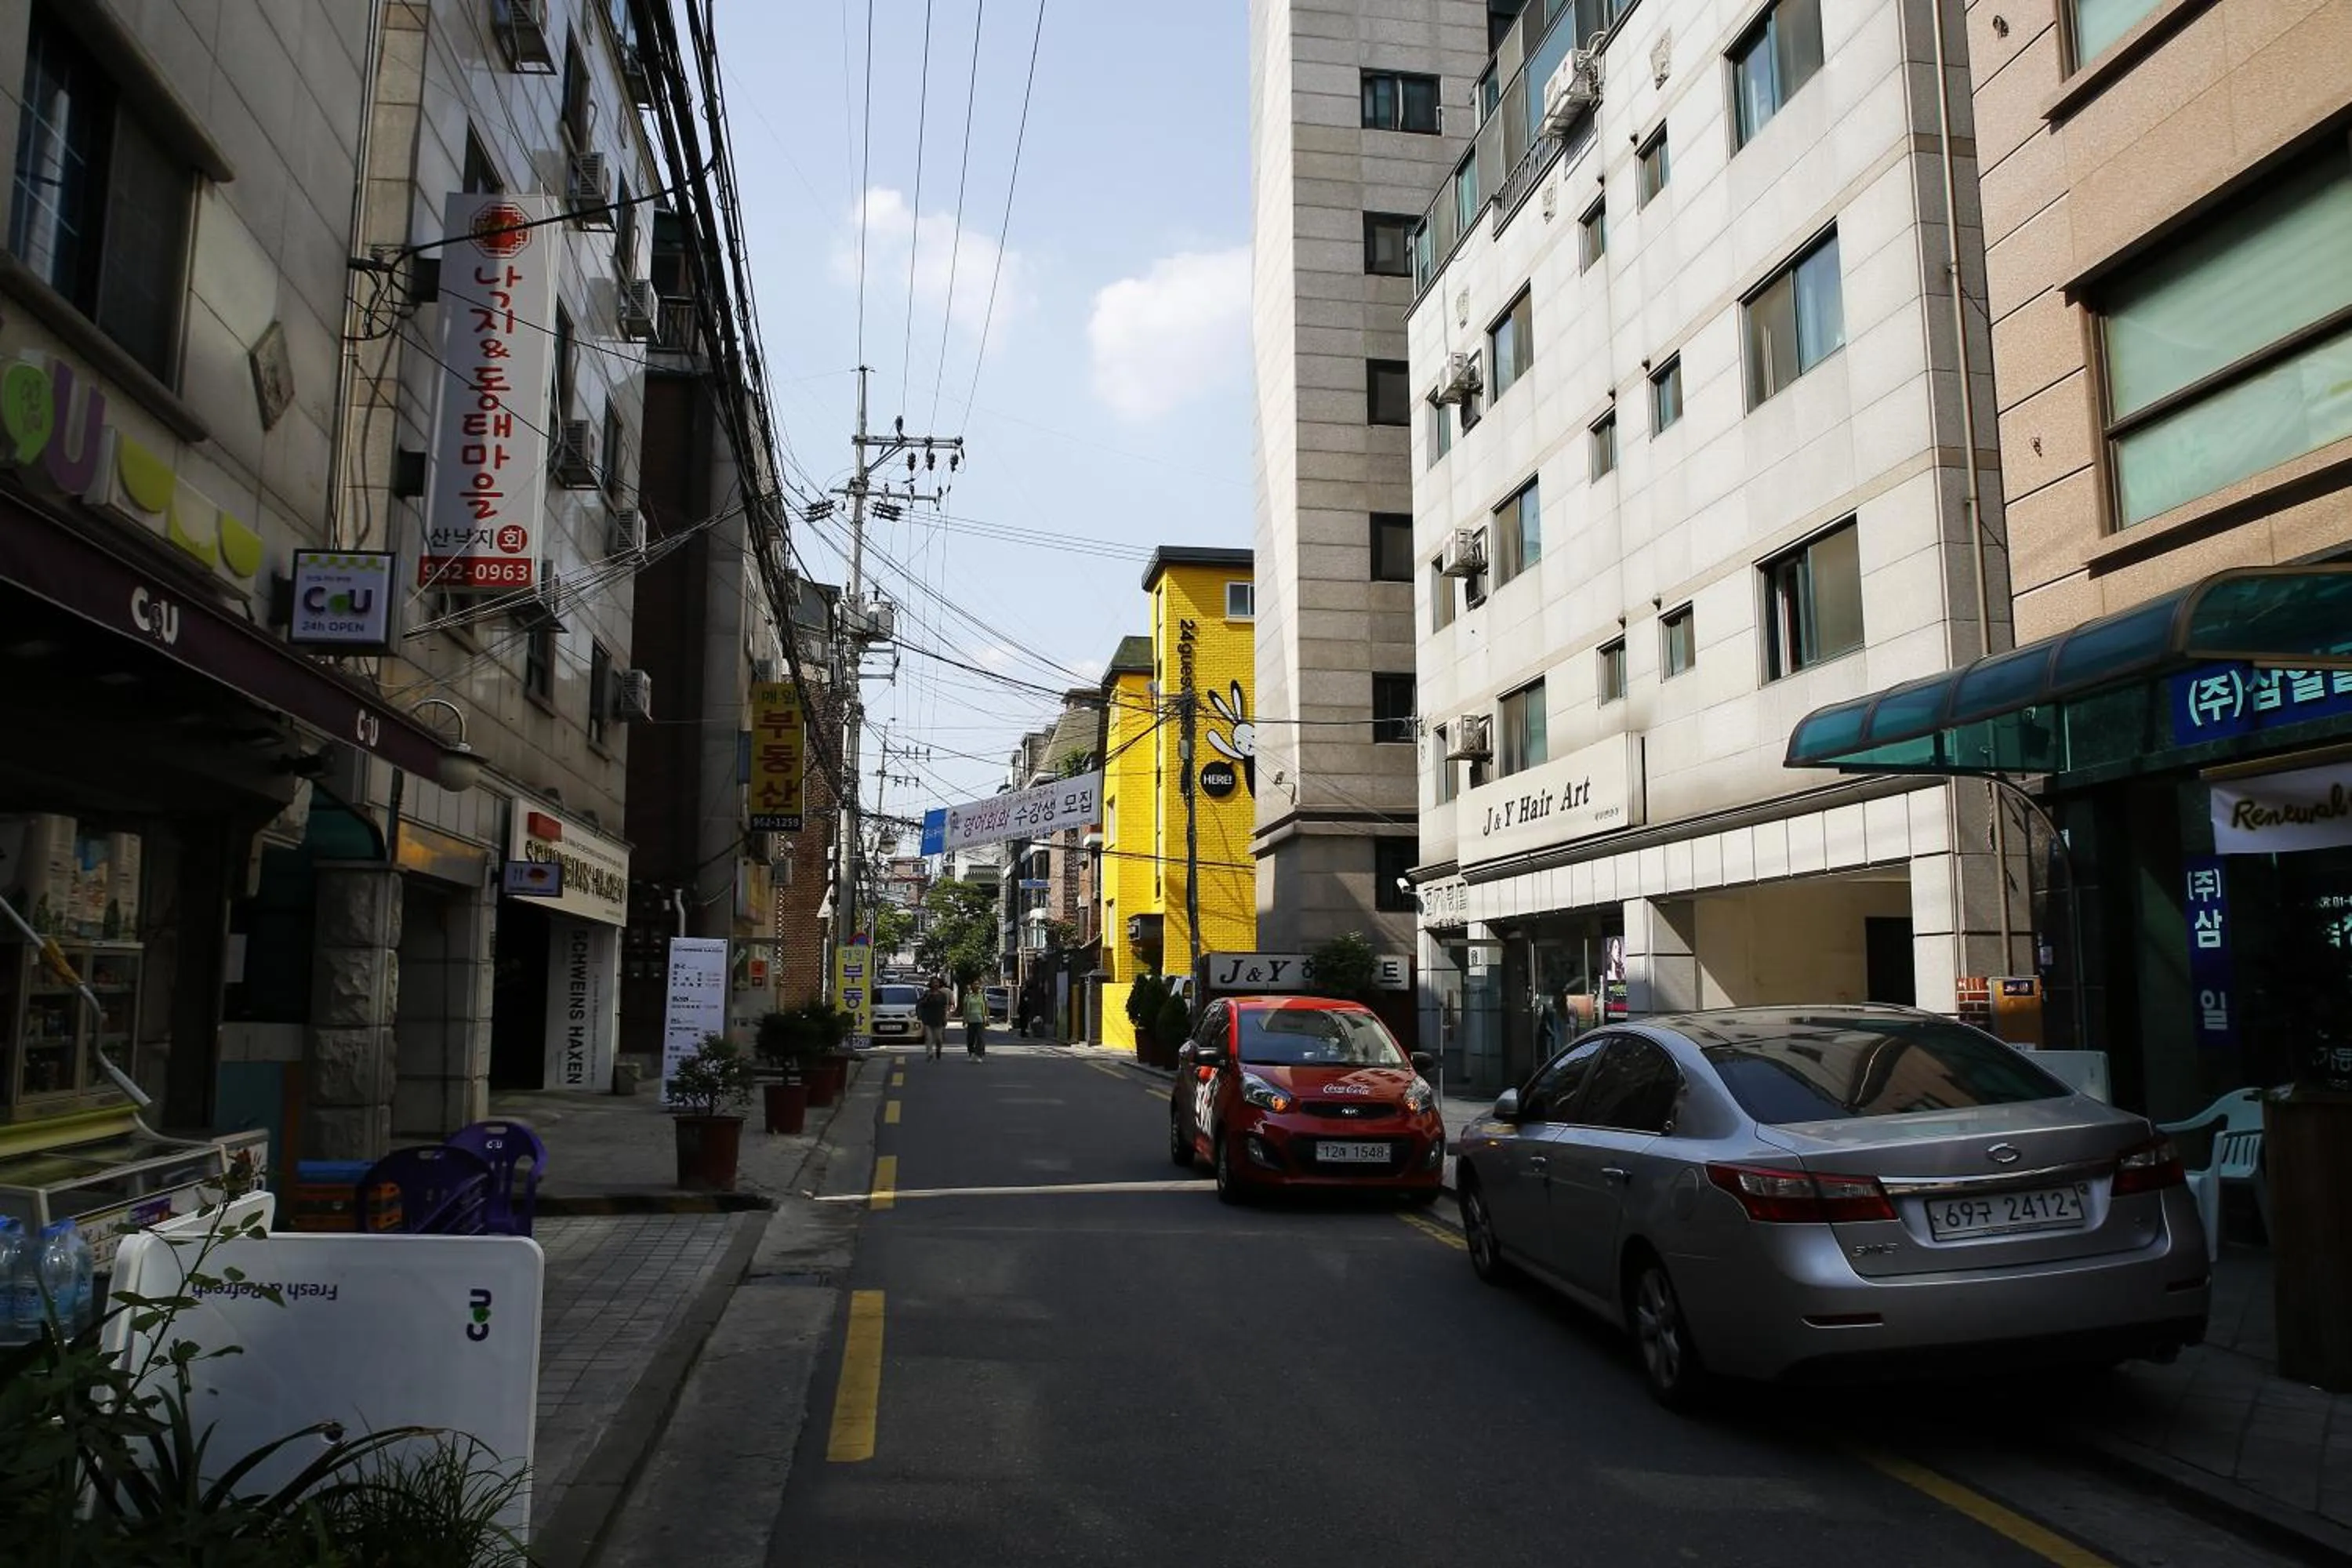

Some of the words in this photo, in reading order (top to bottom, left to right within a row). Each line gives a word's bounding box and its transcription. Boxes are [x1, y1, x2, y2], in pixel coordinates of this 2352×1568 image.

[424, 562, 528, 582] 962-0963
[328, 622, 365, 632] OPEN
[757, 710, 800, 808] 부동산
[1203, 774, 1232, 785] HERE!
[963, 808, 1011, 837] 영어회화
[1014, 799, 1056, 826] 수강생
[1061, 789, 1093, 815] 모집
[1518, 788, 1553, 823] Hair
[1559, 775, 1591, 811] Art
[569, 929, 588, 1021] SCHWEINS
[566, 1025, 585, 1085] HAXEN
[1354, 1145, 1385, 1158] 1548
[2005, 1192, 2070, 1221] 2412
[287, 1283, 338, 1301] Fresh
